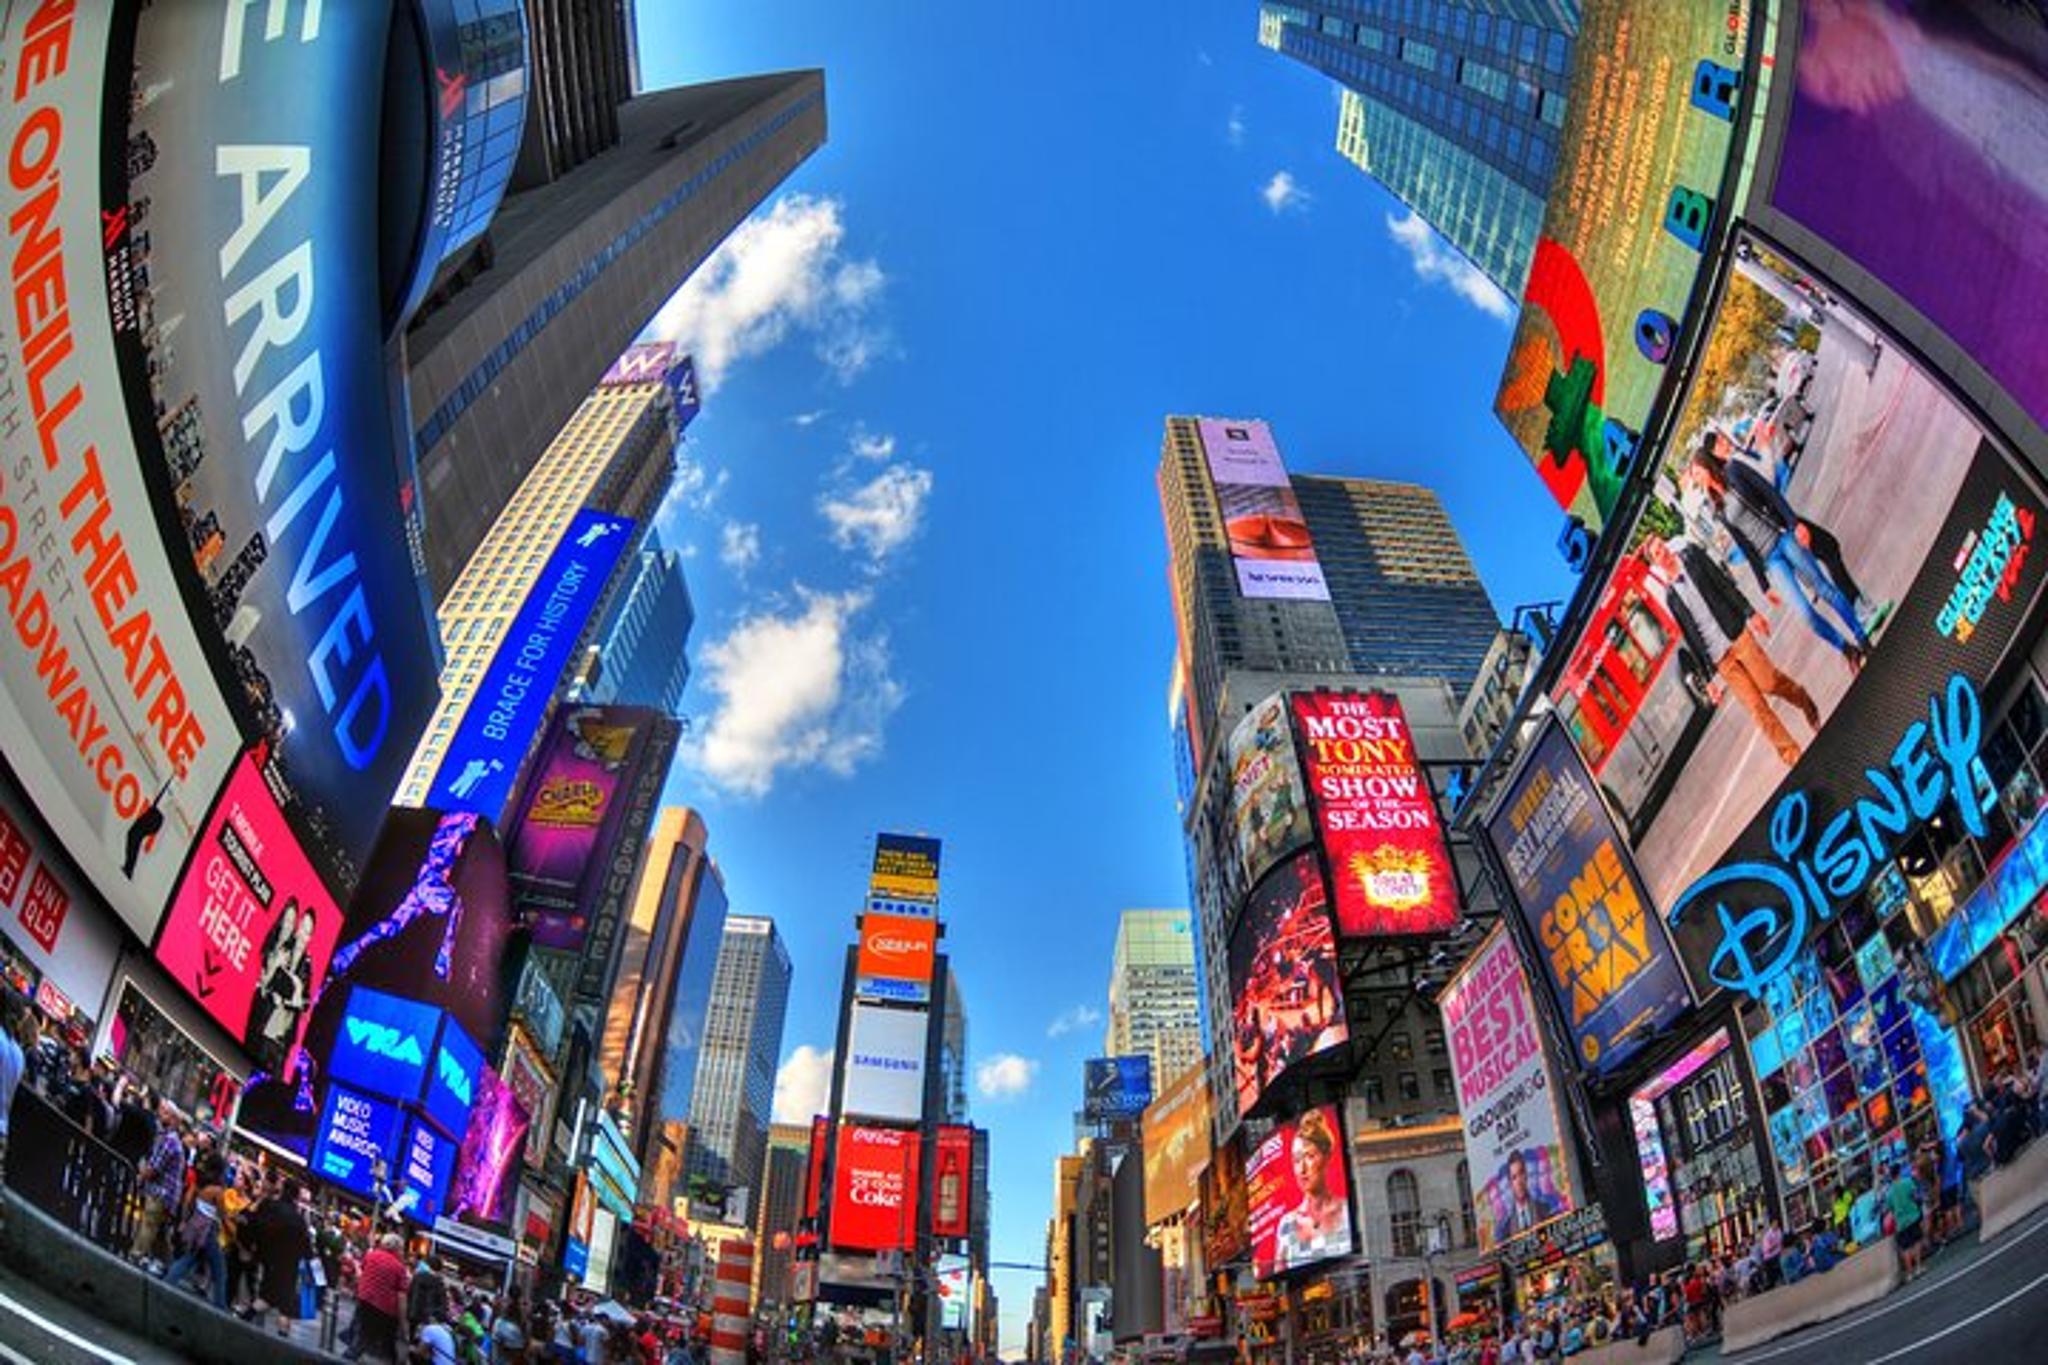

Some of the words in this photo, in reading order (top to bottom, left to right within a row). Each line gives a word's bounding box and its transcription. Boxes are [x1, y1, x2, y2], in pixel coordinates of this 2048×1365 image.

[8, 106, 84, 472] O'NEILL
[58, 446, 206, 768] THEATRE
[216, 145, 392, 771] ARRIVED
[483, 674, 533, 741] BRACE
[517, 630, 551, 674] FOR
[535, 560, 588, 634] HISTORY
[1329, 701, 1372, 717] THE
[1306, 716, 1401, 740] MOST
[1310, 738, 1407, 763] TONY
[1322, 776, 1418, 799] SHOW
[1328, 810, 1430, 830] SEASON
[34, 878, 62, 914] UNI
[205, 856, 243, 912] GET
[239, 891, 258, 929] IT
[1539, 837, 1626, 948] COME
[25, 900, 56, 942] QLO
[199, 897, 251, 972] HERE
[1453, 969, 1527, 1080] BEST
[853, 1054, 919, 1071] SAMSUNG
[1461, 1021, 1538, 1107] MUSICAL
[336, 1093, 372, 1118] VIDEO
[332, 1112, 372, 1138] MUSIC
[849, 1187, 902, 1208] Coke
